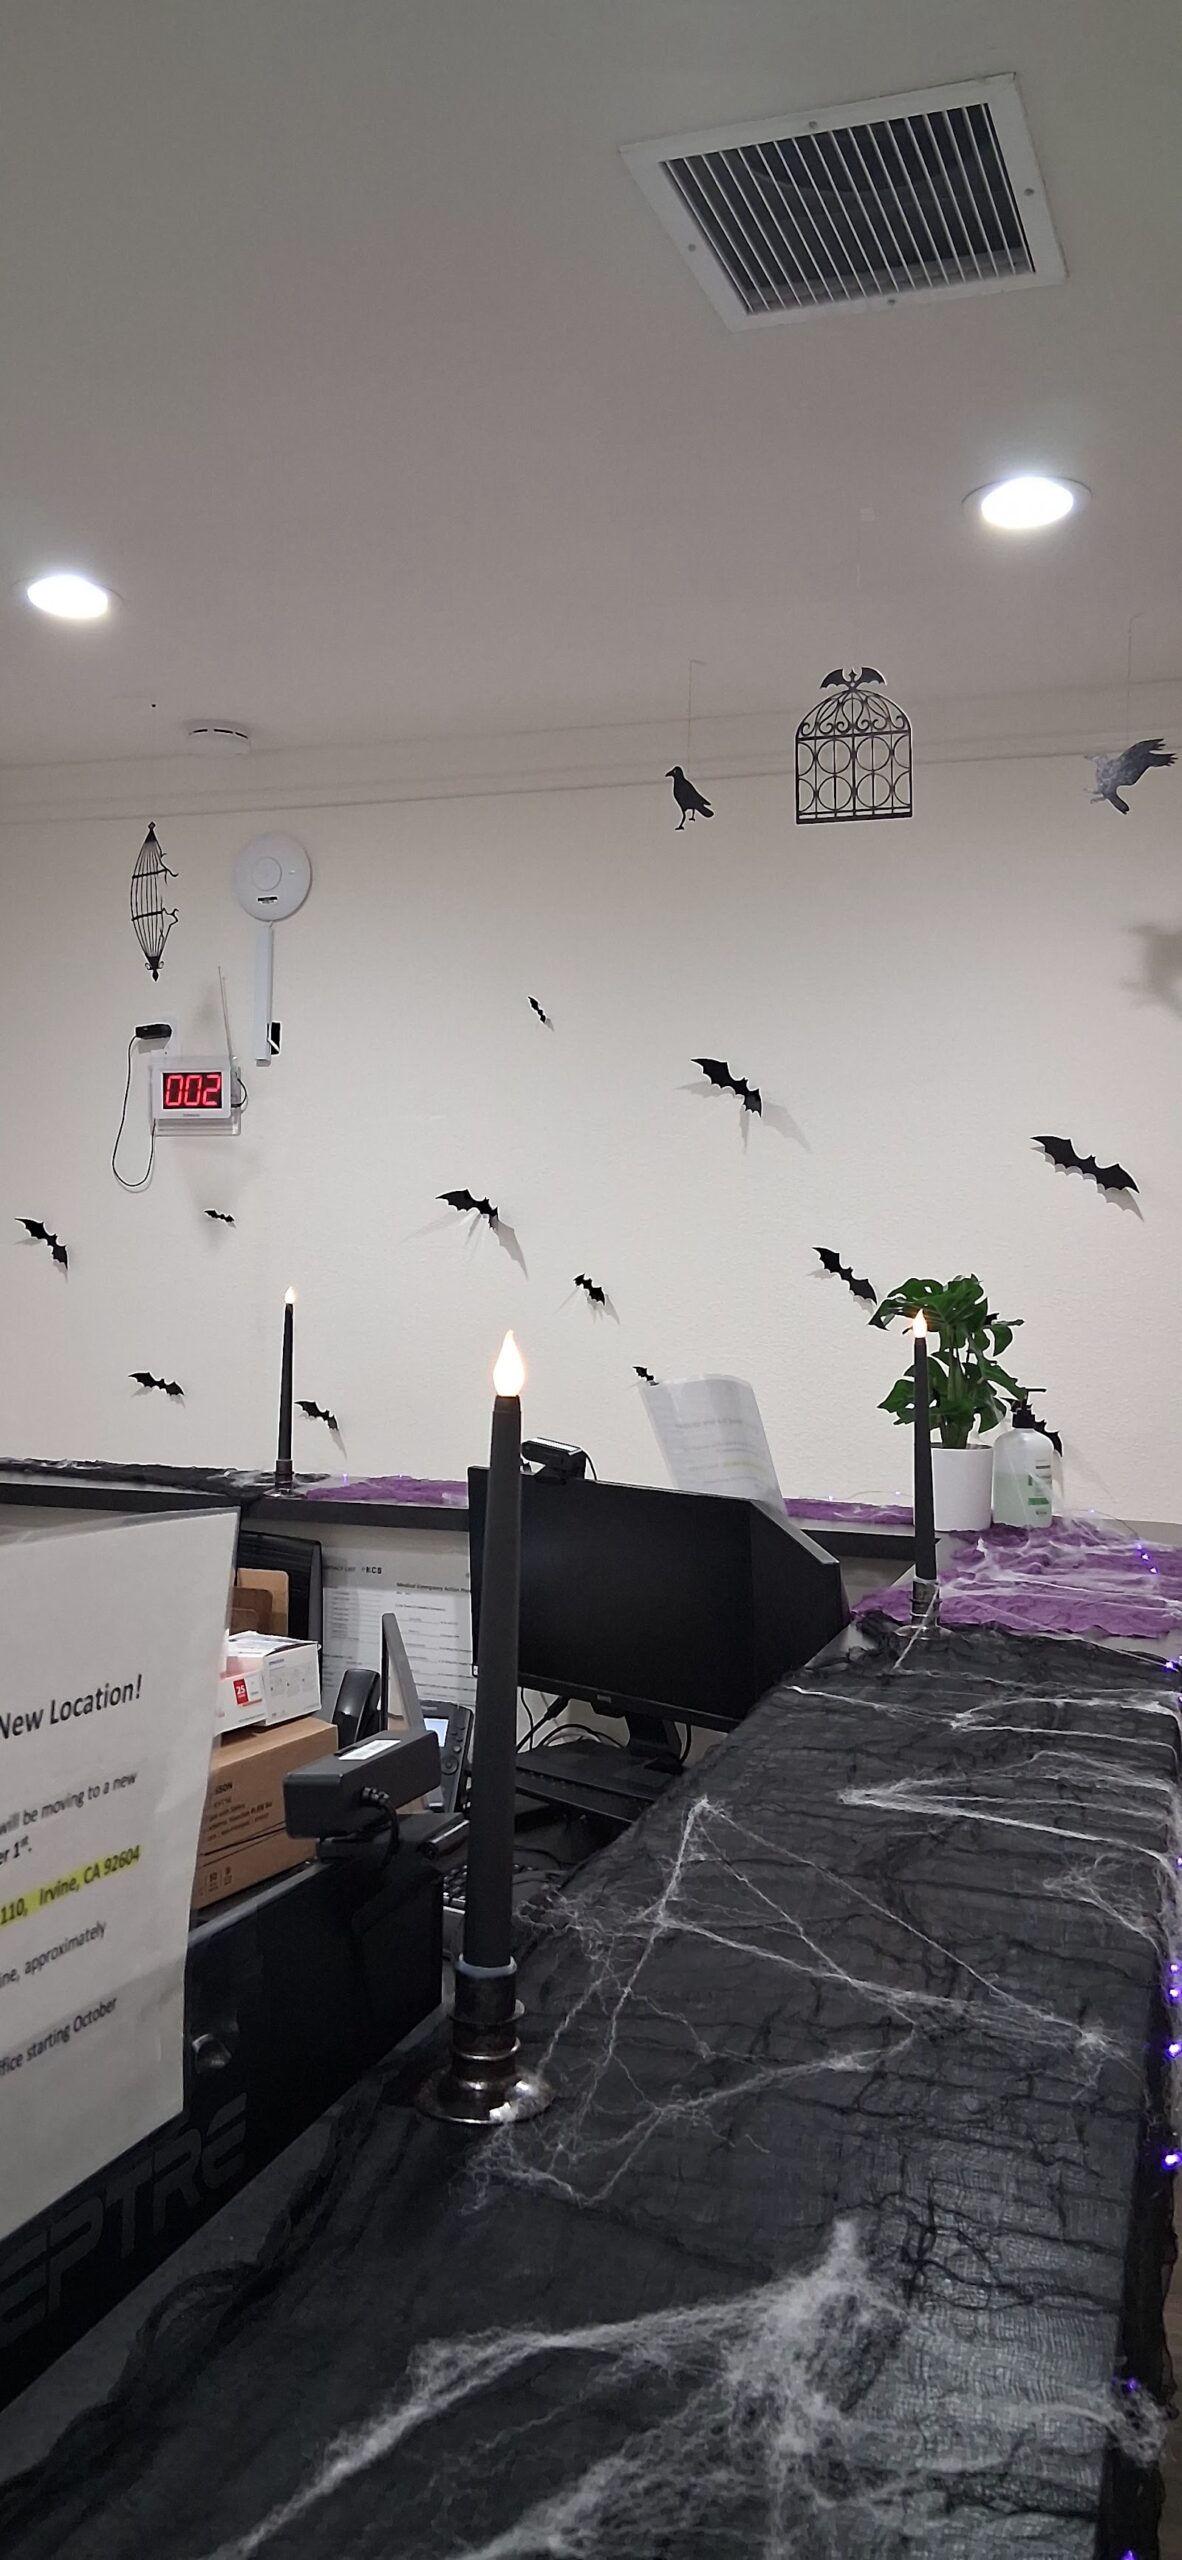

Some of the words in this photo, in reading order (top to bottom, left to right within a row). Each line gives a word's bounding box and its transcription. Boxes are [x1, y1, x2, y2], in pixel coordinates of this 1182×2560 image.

[165, 1074, 221, 1106] 002
[0, 1709, 44, 1739] New
[50, 1674, 142, 1724] Location!
[236, 1685, 246, 1695] 25
[23, 1809, 38, 1826] be
[41, 1791, 85, 1818] moving
[87, 1785, 100, 1800] to
[103, 1782, 110, 1794] a
[113, 1772, 138, 1791] new
[0, 1898, 28, 1925] 110,
[40, 1879, 80, 1906] Irvine,
[83, 1863, 101, 1884] CA
[104, 1845, 140, 1875] 92604
[25, 1920, 107, 1975] approximately
[27, 2025, 70, 2061] starting
[73, 1998, 117, 2032] October
